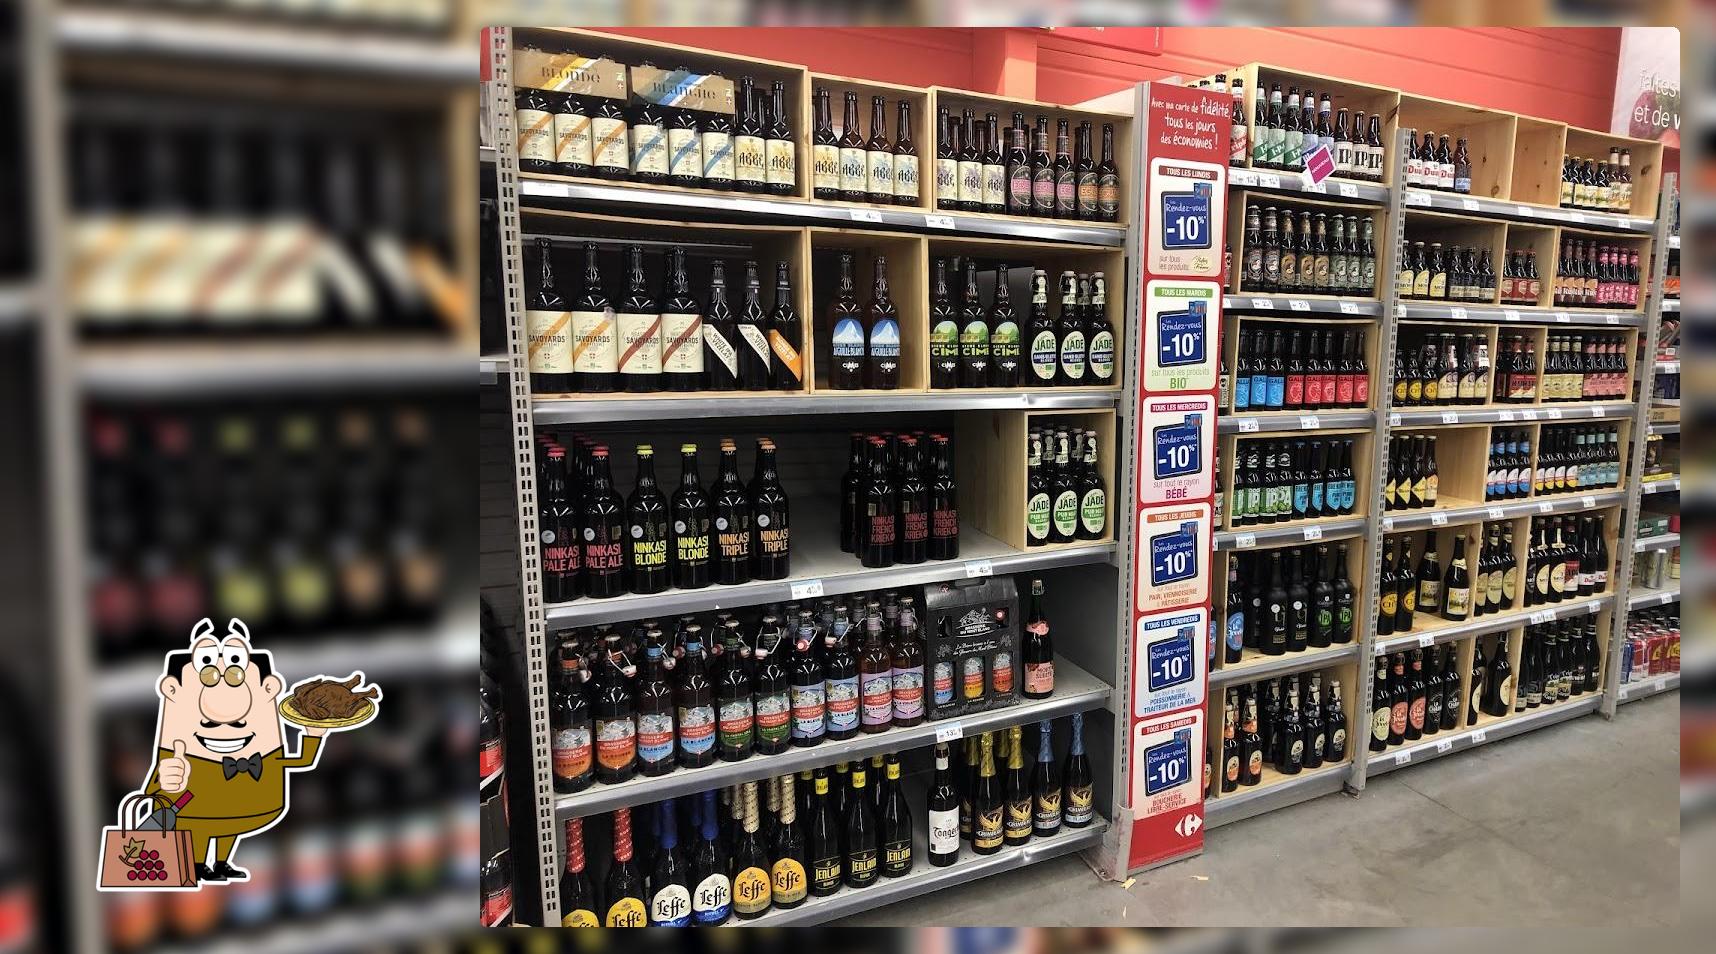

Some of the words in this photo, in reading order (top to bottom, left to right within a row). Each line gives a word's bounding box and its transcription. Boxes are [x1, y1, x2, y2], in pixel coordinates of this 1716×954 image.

[1152, 96, 1164, 108] Avec
[1175, 102, 1189, 112] carte
[1191, 102, 1198, 113] de
[1199, 96, 1231, 119] fidélité,
[1634, 104, 1650, 124] et
[1652, 105, 1670, 127] de
[1165, 112, 1184, 129] tous
[1195, 117, 1216, 135] jours
[1161, 132, 1171, 145] des
[1172, 131, 1213, 150] économies
[1166, 167, 1180, 176] TOUS
[1181, 168, 1190, 177] LES
[1191, 169, 1211, 179] LUNDIS
[1165, 202, 1206, 213] Rendez-vous
[1161, 288, 1175, 296] TOUS
[1176, 288, 1185, 296] LES
[1161, 320, 1202, 331] Rendez-vous
[528, 335, 566, 344] SAVOYARDS
[575, 335, 610, 344] SAVOYARDS
[626, 336, 660, 345] SAVOYARDS
[666, 336, 699, 345] SAVOYARDS
[1034, 339, 1055, 351] JADE
[1064, 339, 1084, 351] JADE
[1093, 339, 1112, 351] JADE
[1170, 377, 1186, 389] BIO
[1177, 402, 1206, 410] MERCREDIS
[1157, 434, 1196, 445] Rendez-vous
[1165, 487, 1187, 499] BÉBÉ
[1030, 499, 1049, 512] JADE
[1058, 497, 1076, 510] JADE
[1085, 495, 1104, 507] JADE
[677, 534, 709, 549] NINKASI
[718, 531, 749, 545] NINKASI
[760, 529, 789, 543] NINKASI
[544, 545, 580, 560] NINKASI
[586, 542, 621, 557] NINKASI
[633, 540, 667, 554] NINKASI
[678, 546, 709, 560] BLONDE
[720, 543, 748, 557] TRIPLE
[762, 540, 788, 554] TRIPLE
[1154, 541, 1192, 553] Rendez-vous
[543, 557, 566, 571] PALE
[585, 555, 606, 569] PALE
[607, 553, 623, 567] ALE
[634, 551, 666, 566] BLONDE
[1147, 621, 1160, 629] TOUS
[1171, 615, 1198, 625] VENDREDIS
[1152, 645, 1190, 660] Rendez-vous
[1147, 725, 1160, 733] TOUS
[1170, 718, 1192, 729] SAMEDIS
[1148, 747, 1187, 764] Rendez-vous
[774, 869, 800, 890] Leffe
[700, 886, 728, 906] Leffe
[738, 879, 766, 901] Leffe
[657, 897, 686, 919] Leffe
